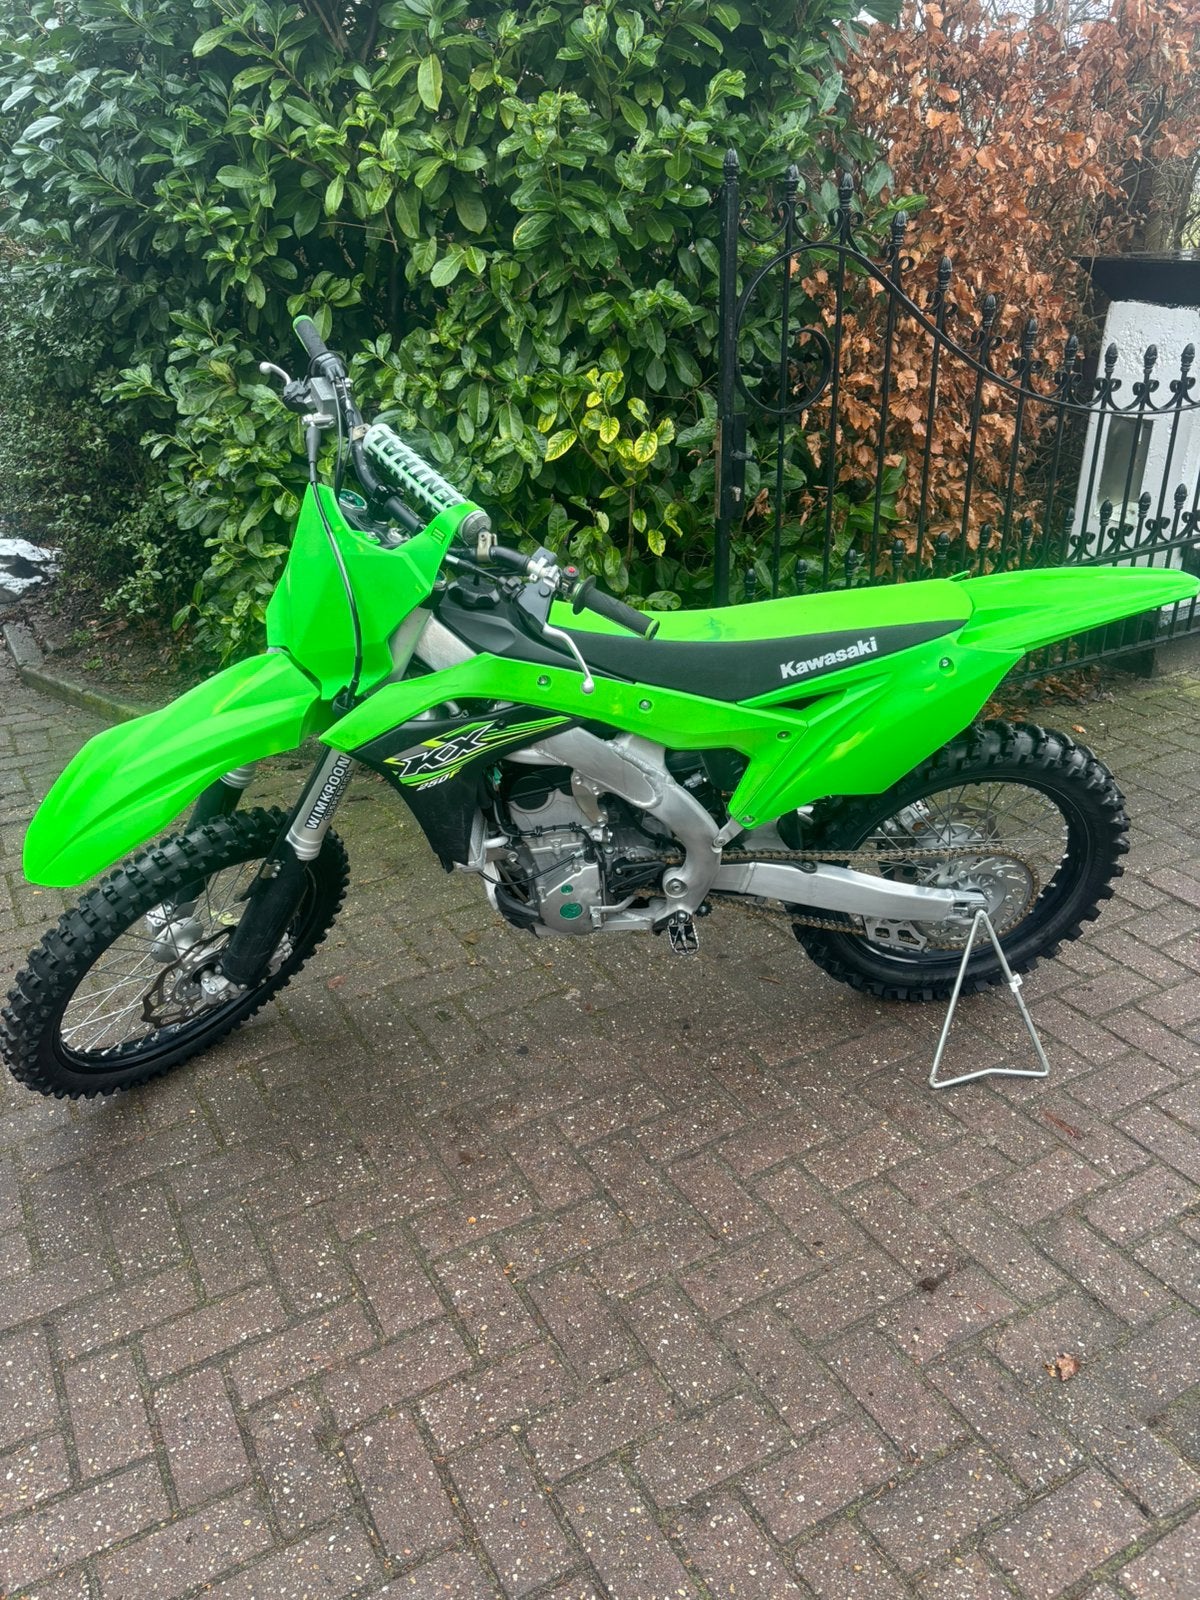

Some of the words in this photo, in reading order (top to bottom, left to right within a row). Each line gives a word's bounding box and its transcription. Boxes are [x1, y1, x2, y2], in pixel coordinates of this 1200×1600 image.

[780, 636, 878, 679] Kawasaki
[400, 720, 496, 778] KX
[305, 756, 352, 830] WIMKROON
